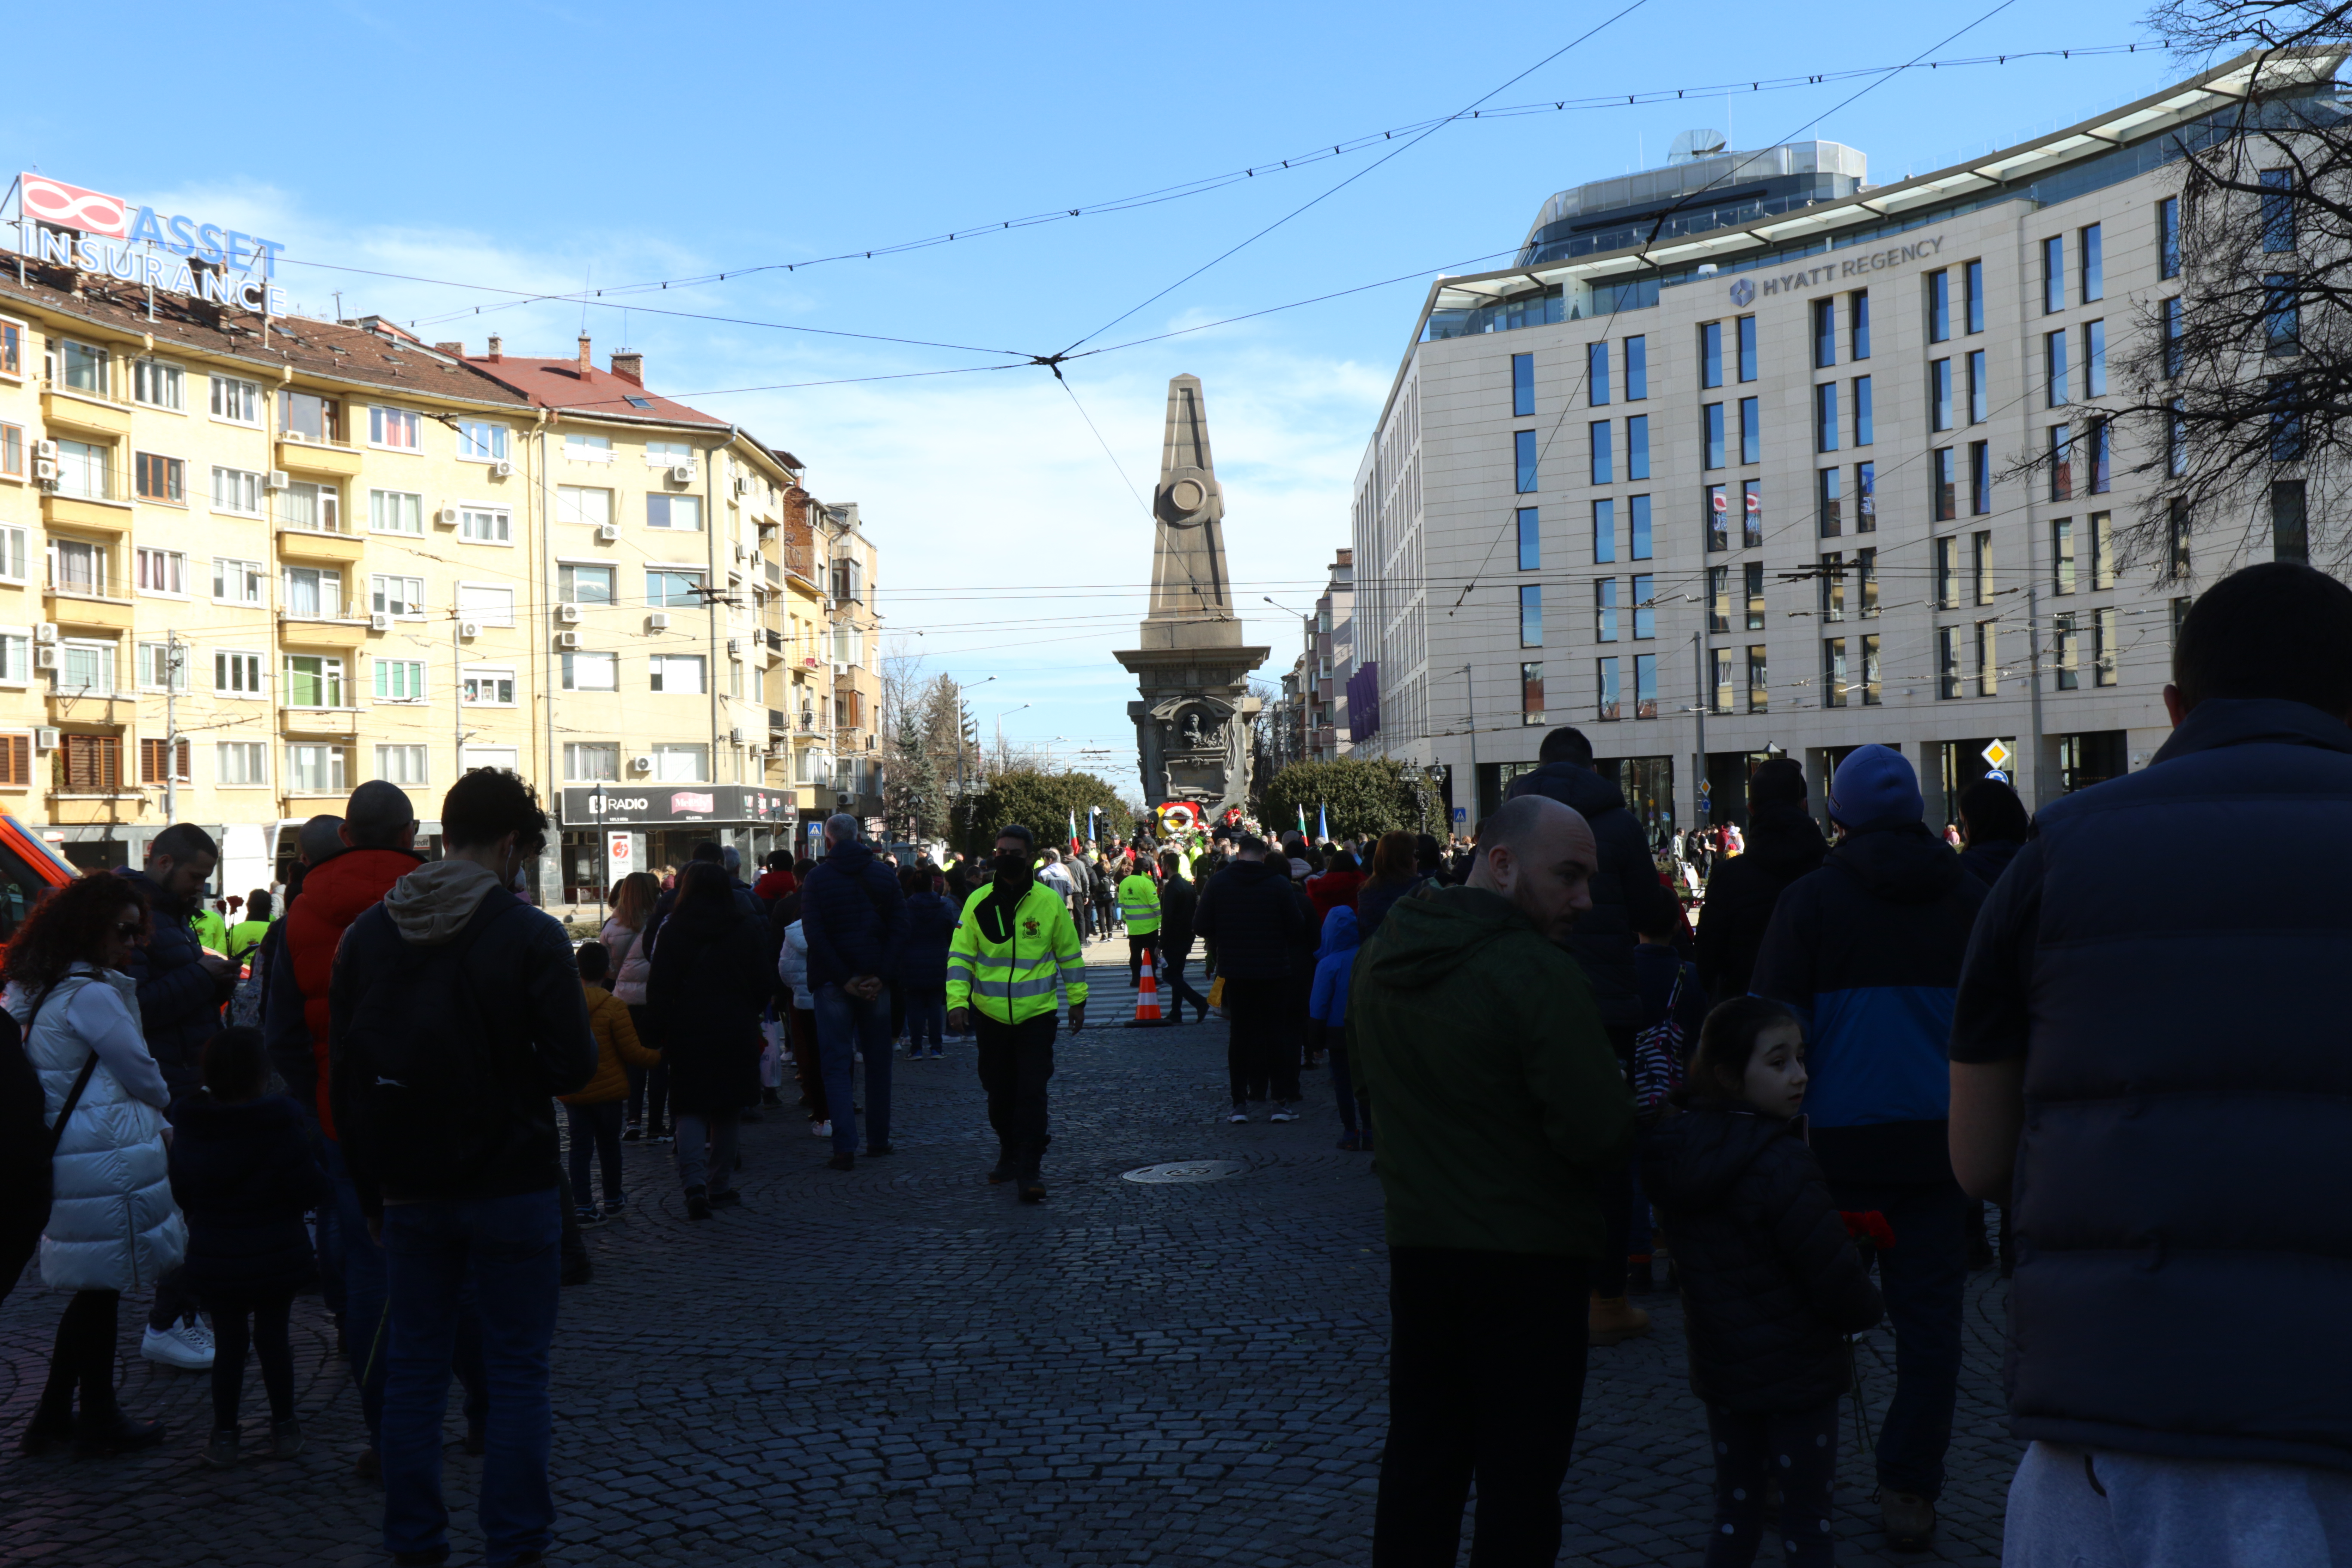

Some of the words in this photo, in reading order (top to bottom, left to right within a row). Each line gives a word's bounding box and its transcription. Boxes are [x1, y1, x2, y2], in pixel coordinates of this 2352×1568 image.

[21, 224, 287, 318] INSURANCE
[129, 205, 285, 279] ASSET
[1763, 263, 1836, 296] HYATT
[1842, 235, 1942, 278] REGENCY
[608, 798, 648, 810] RADIO
[675, 796, 707, 811] Melody
